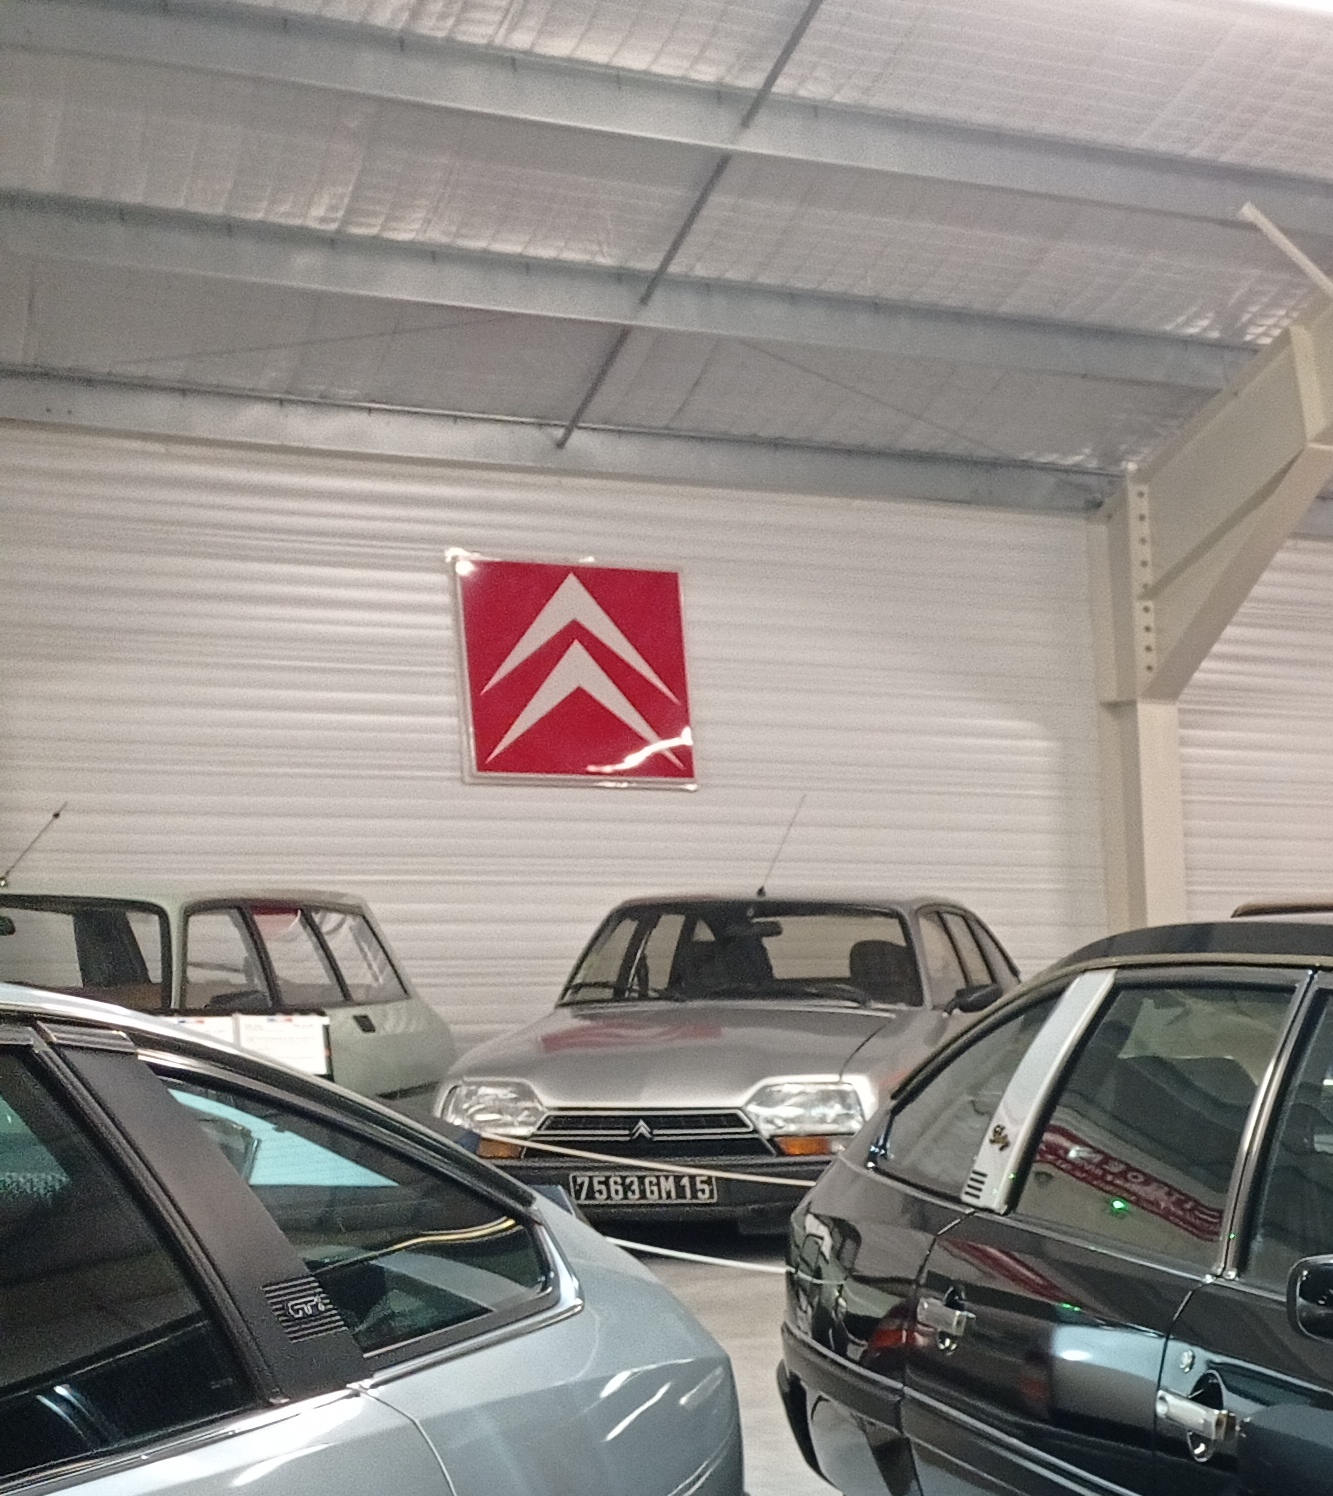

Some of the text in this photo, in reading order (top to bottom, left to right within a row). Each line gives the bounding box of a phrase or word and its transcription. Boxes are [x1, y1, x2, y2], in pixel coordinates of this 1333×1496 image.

[575, 1174, 711, 1201] 7563 GM 15
